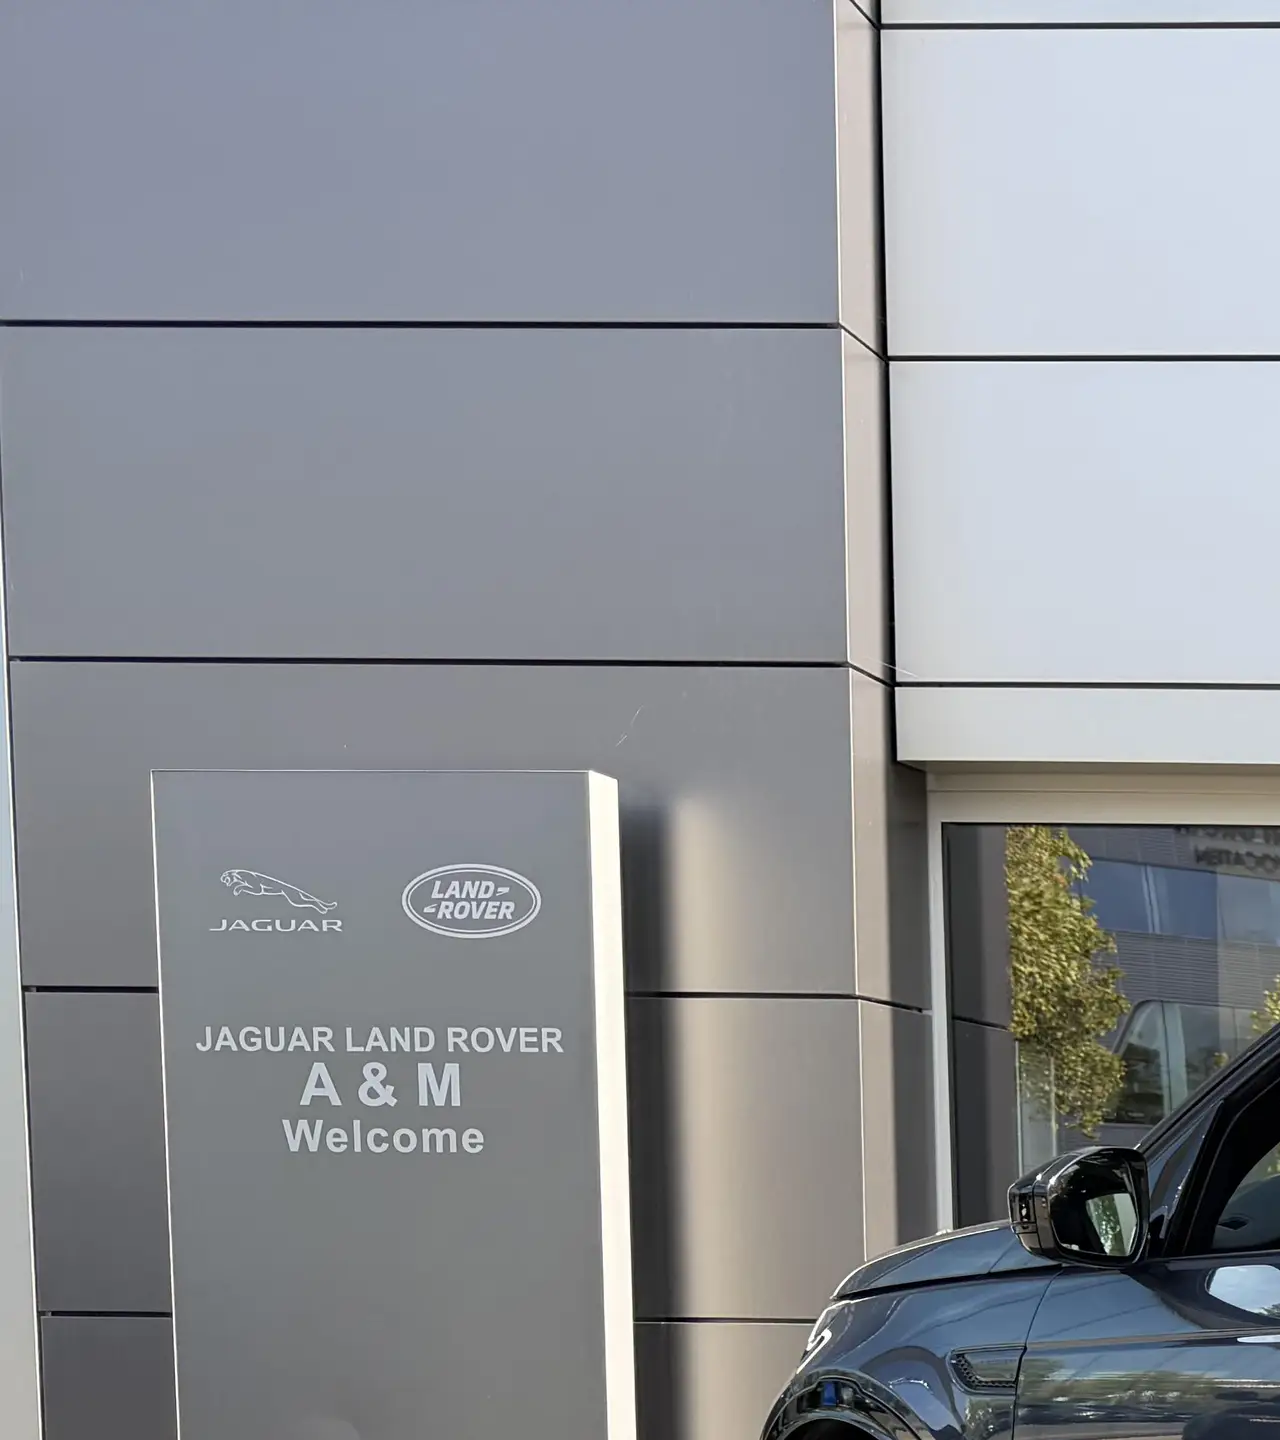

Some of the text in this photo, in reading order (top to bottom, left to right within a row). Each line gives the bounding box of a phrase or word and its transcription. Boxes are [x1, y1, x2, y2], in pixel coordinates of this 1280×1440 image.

[431, 880, 495, 899] LAND
[436, 900, 515, 920] ROVER
[209, 918, 343, 932] JAGUAR
[195, 1025, 564, 1053] JAGUAR LAND ROVER
[300, 1061, 461, 1107] A & M
[281, 1118, 485, 1153] Welcome
